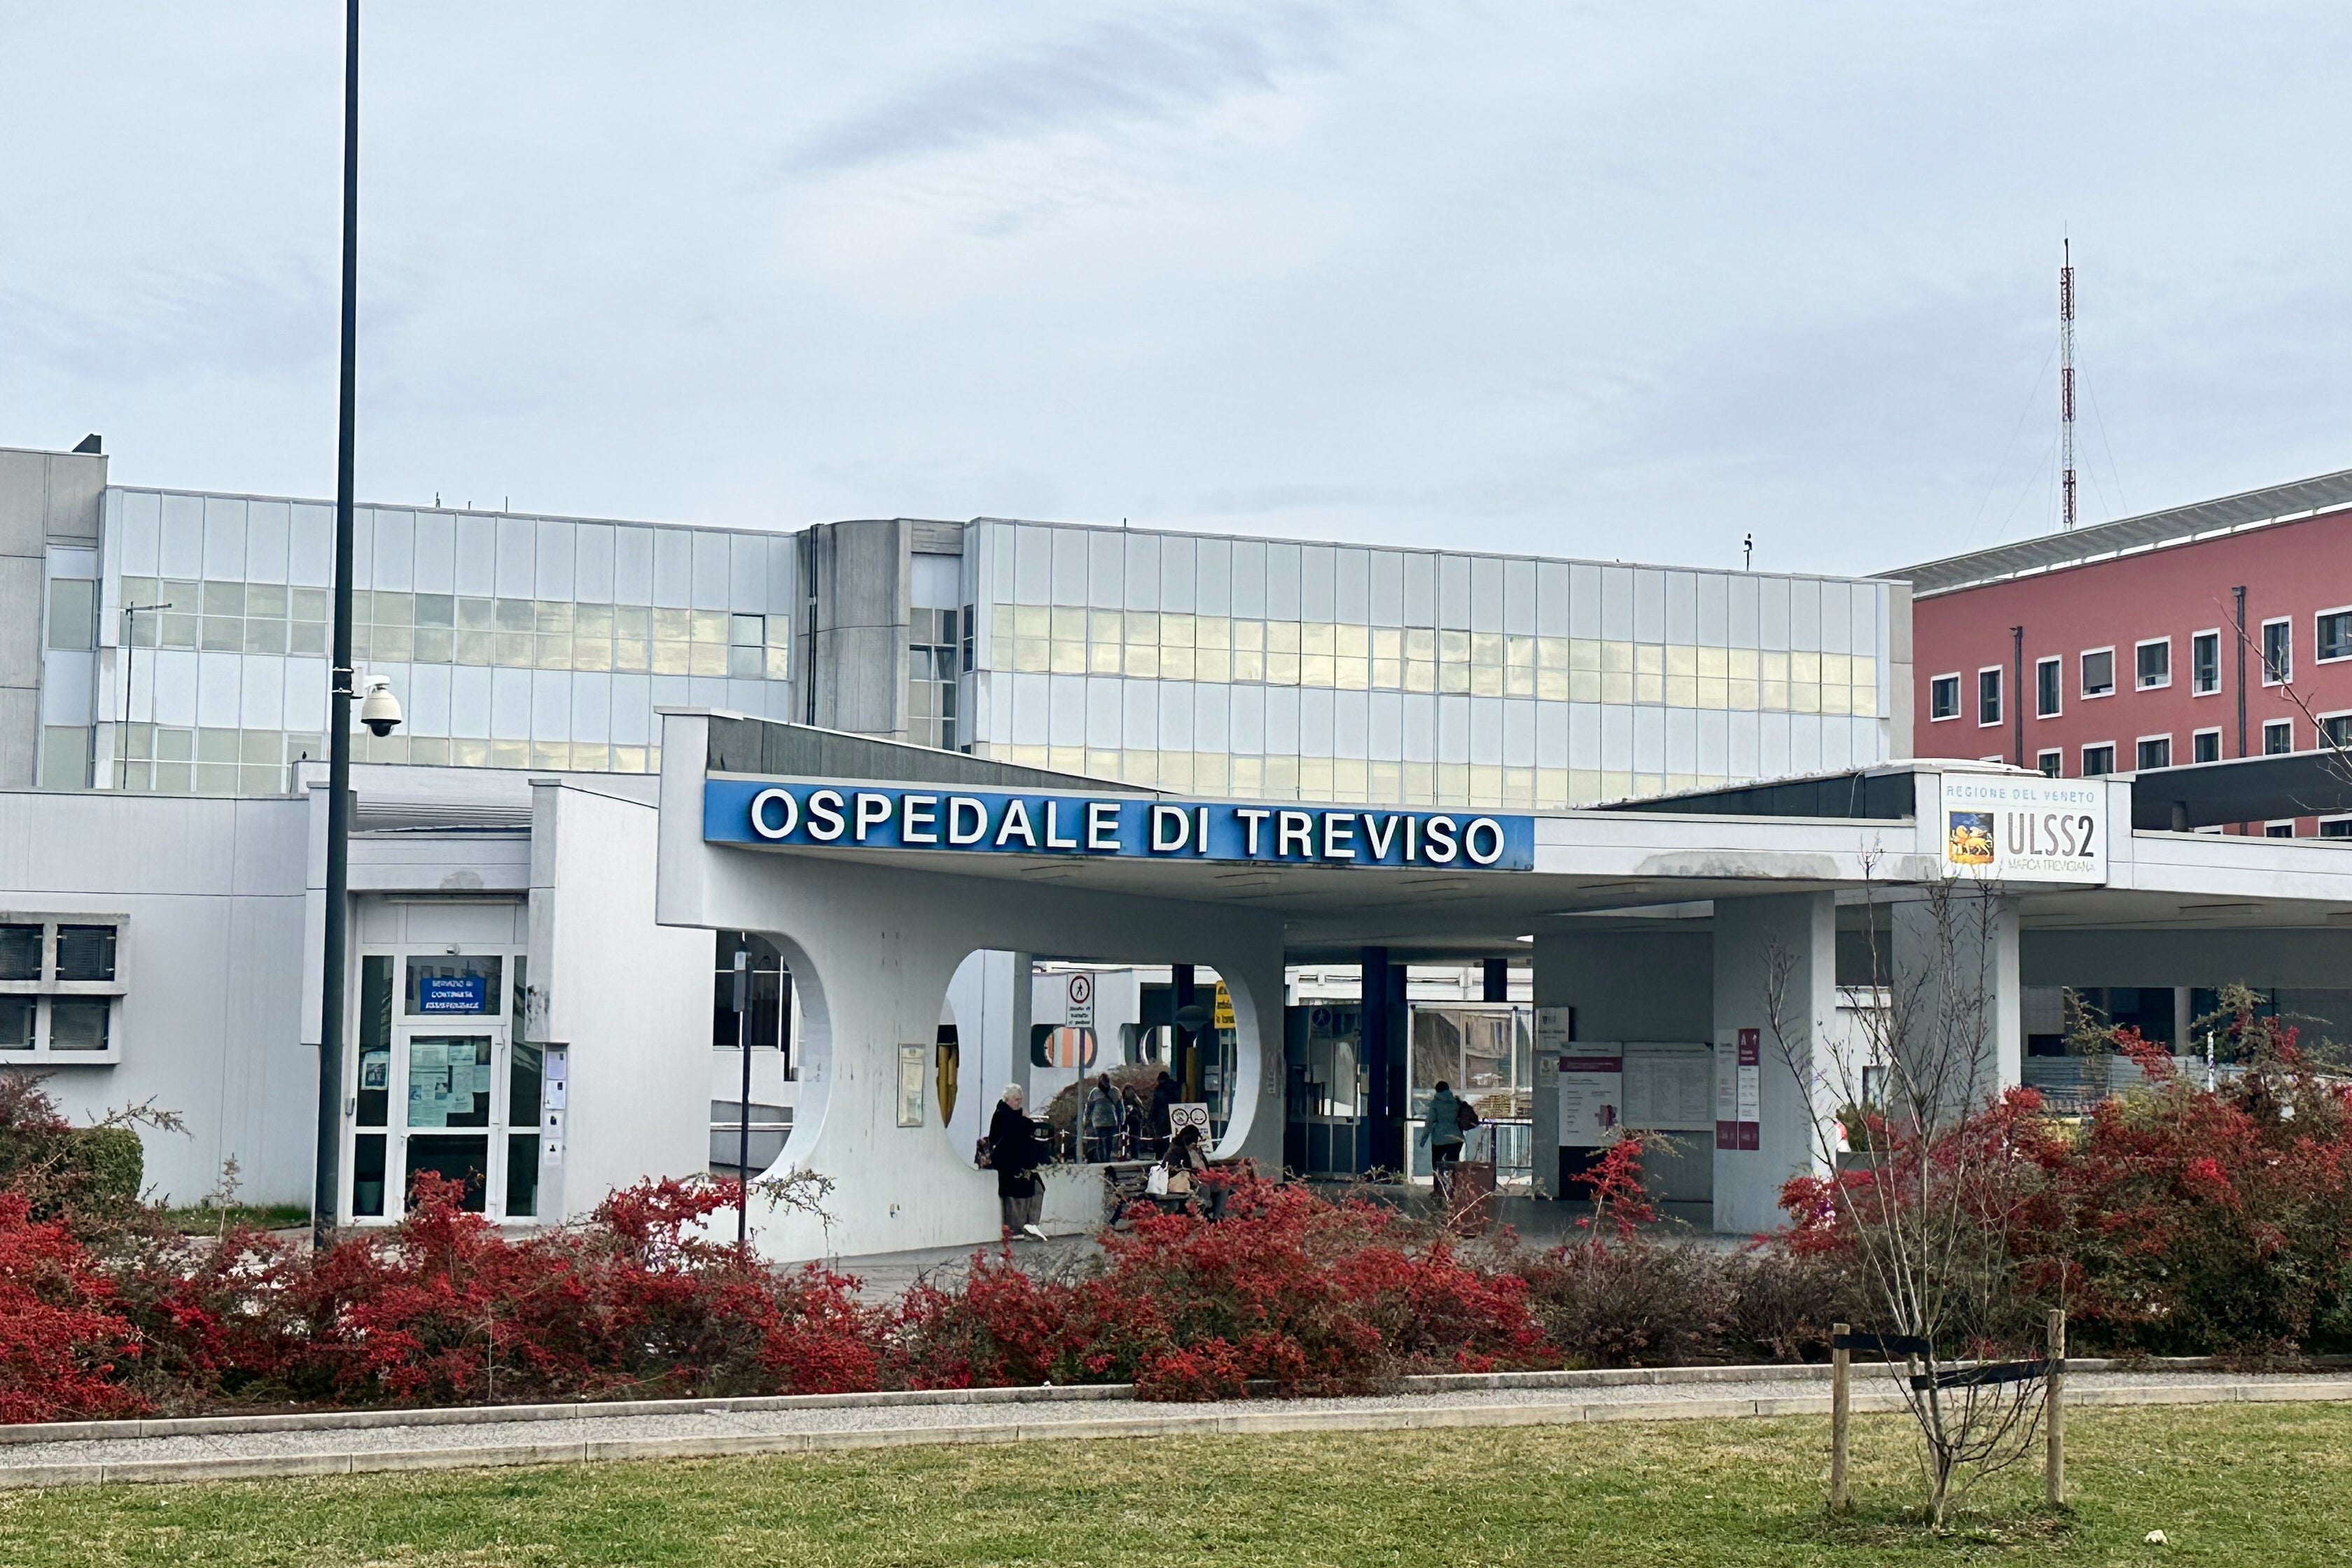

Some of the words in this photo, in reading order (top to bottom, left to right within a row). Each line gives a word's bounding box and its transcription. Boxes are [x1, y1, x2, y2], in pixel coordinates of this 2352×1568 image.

[1947, 785, 2006, 798] REGIONE
[2012, 789, 2036, 800] DEL
[2044, 791, 2094, 803] VENETO
[749, 788, 1122, 850] OSPEDALE
[1150, 804, 1209, 853] DI
[1234, 808, 1505, 865] TREVISO
[2007, 812, 2094, 858] ULSS2
